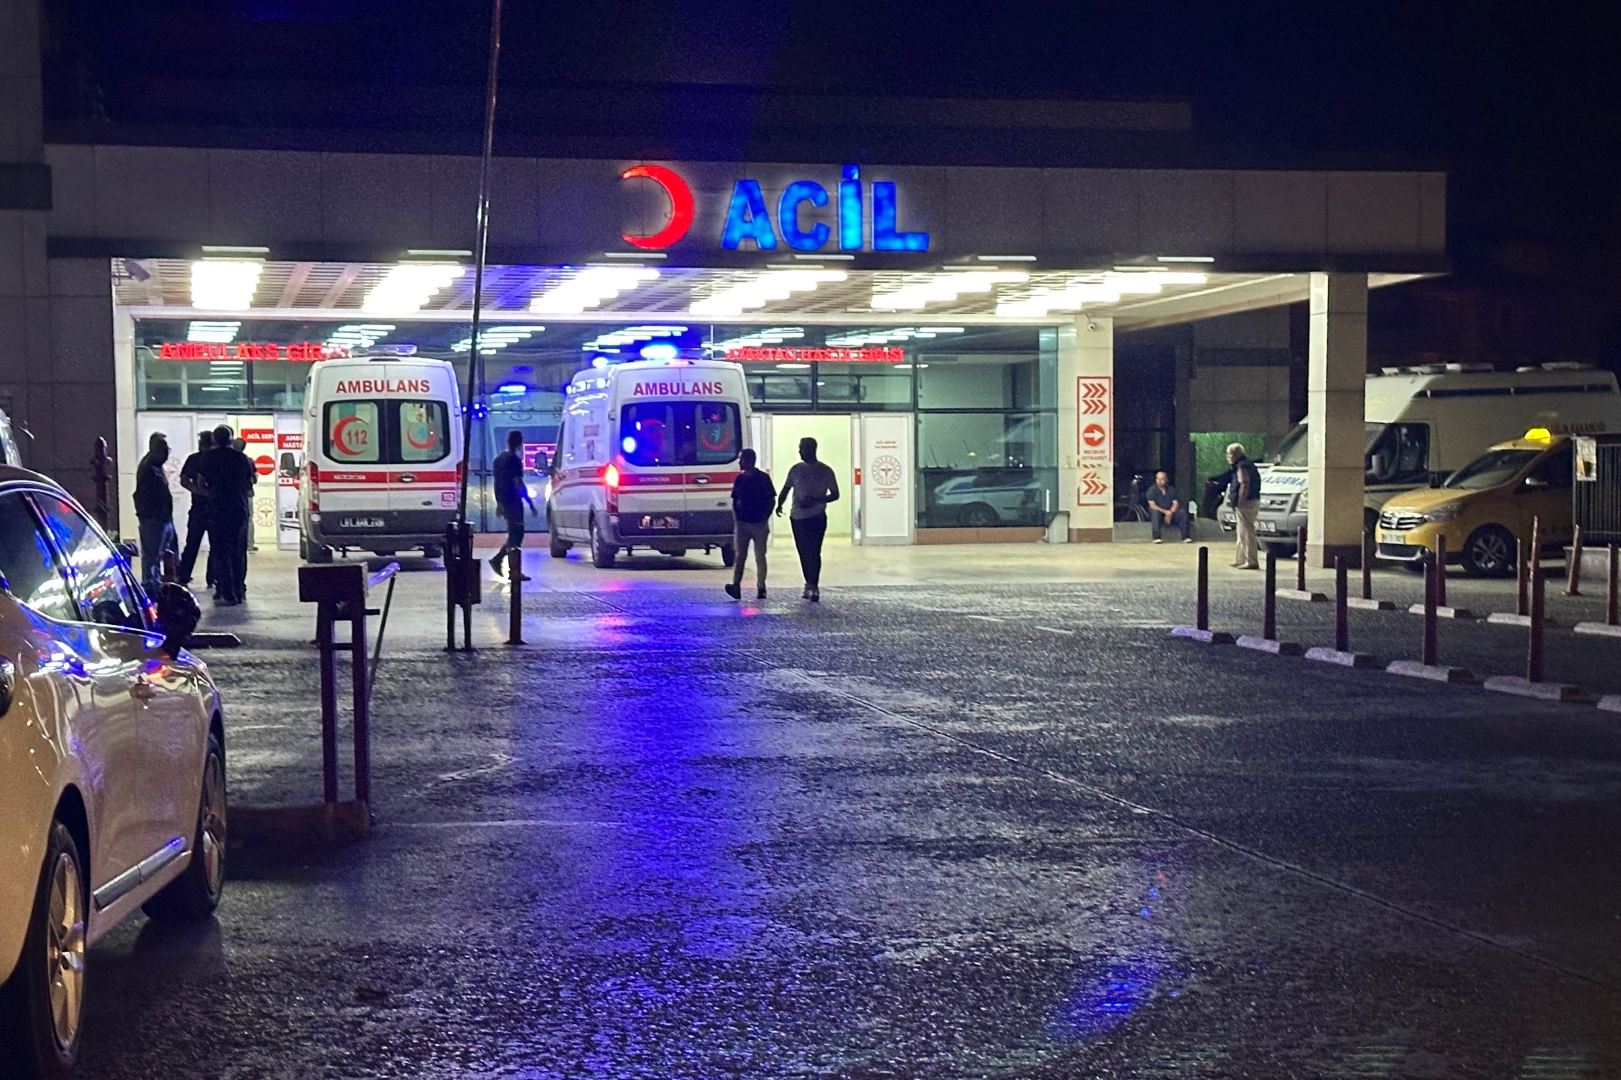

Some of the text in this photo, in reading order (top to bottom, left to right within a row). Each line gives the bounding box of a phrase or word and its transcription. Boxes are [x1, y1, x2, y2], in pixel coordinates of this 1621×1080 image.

[720, 163, 930, 251] ACİL
[159, 340, 349, 362] AMBULANS GİR
[336, 380, 430, 394] AMBULANS
[633, 381, 723, 396] AMBULANS
[346, 429, 368, 445] 112
